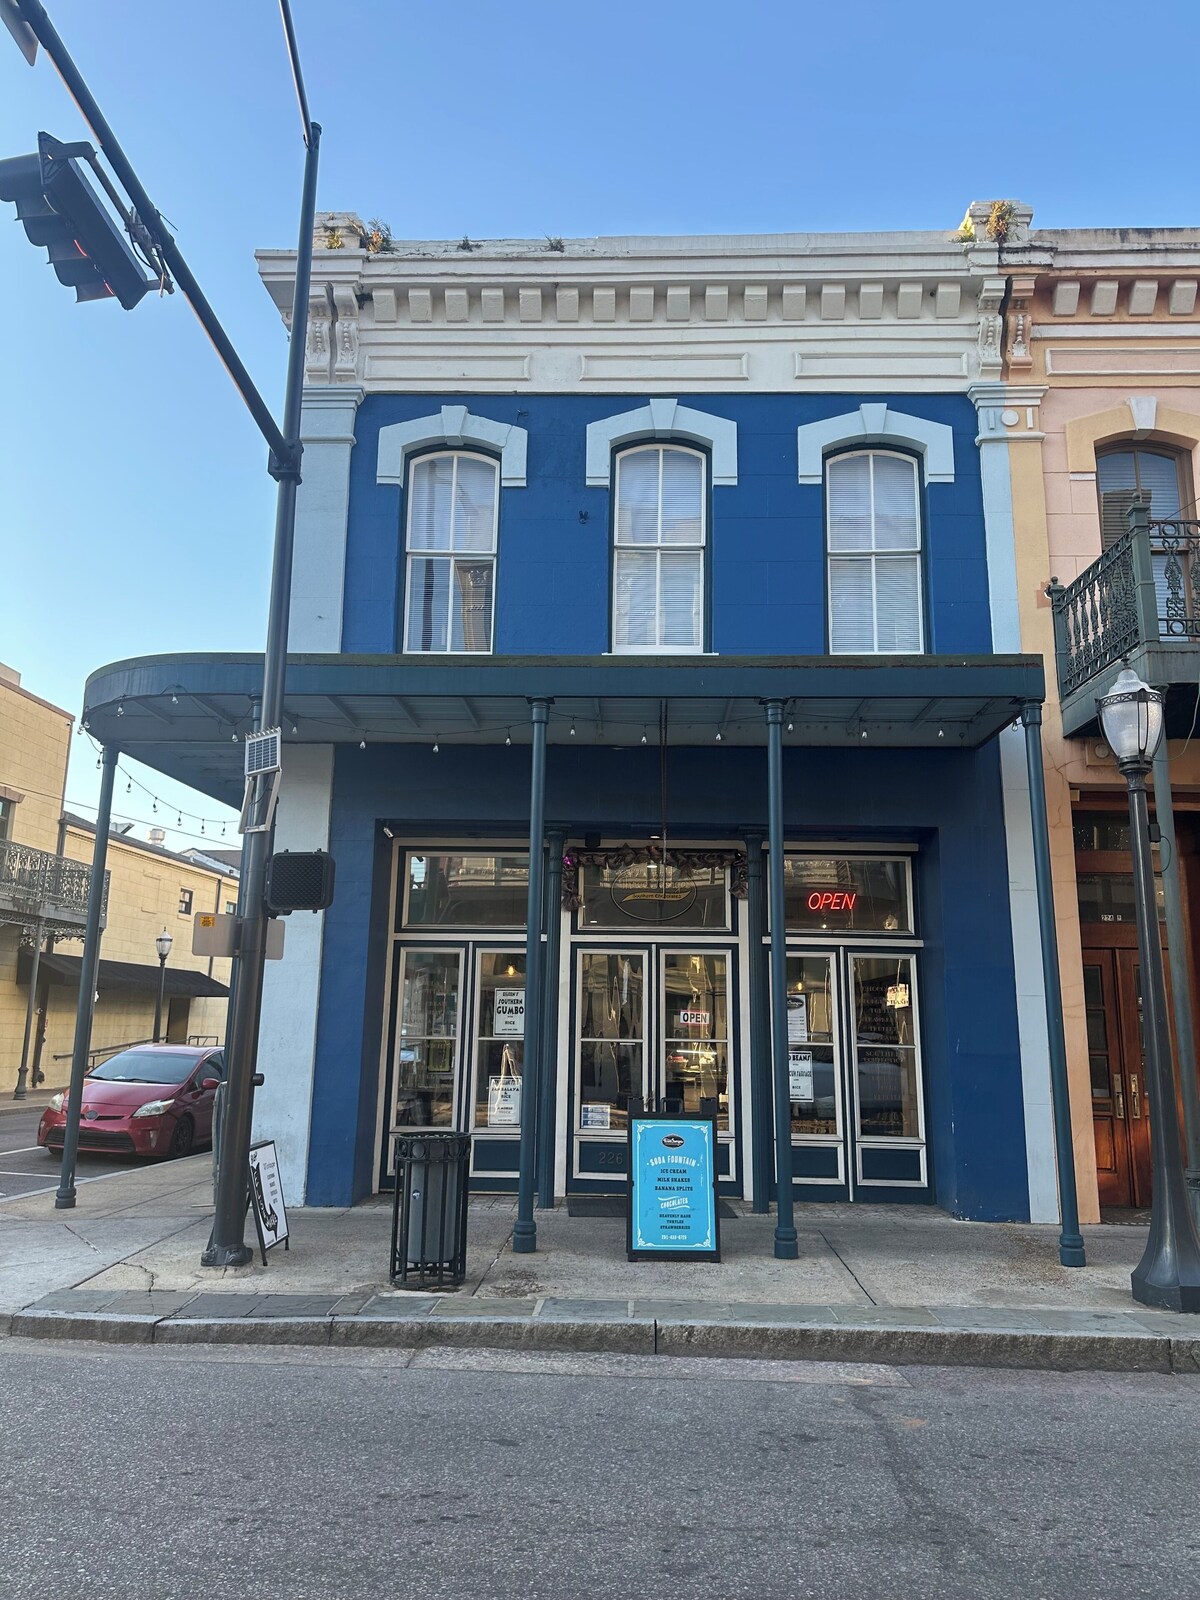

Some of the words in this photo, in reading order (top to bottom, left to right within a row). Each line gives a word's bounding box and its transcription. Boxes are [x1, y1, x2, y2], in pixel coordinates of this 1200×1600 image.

[808, 892, 857, 910] OPEN
[496, 1005, 525, 1015] GUMBO
[683, 1012, 707, 1023] OPEN
[792, 1054, 811, 1062] BEANS
[599, 1151, 623, 1165] 226
[650, 1156, 666, 1167] SODA
[667, 1155, 697, 1167] FOUNTAIN
[660, 1197, 688, 1209] CHOCOLATES
